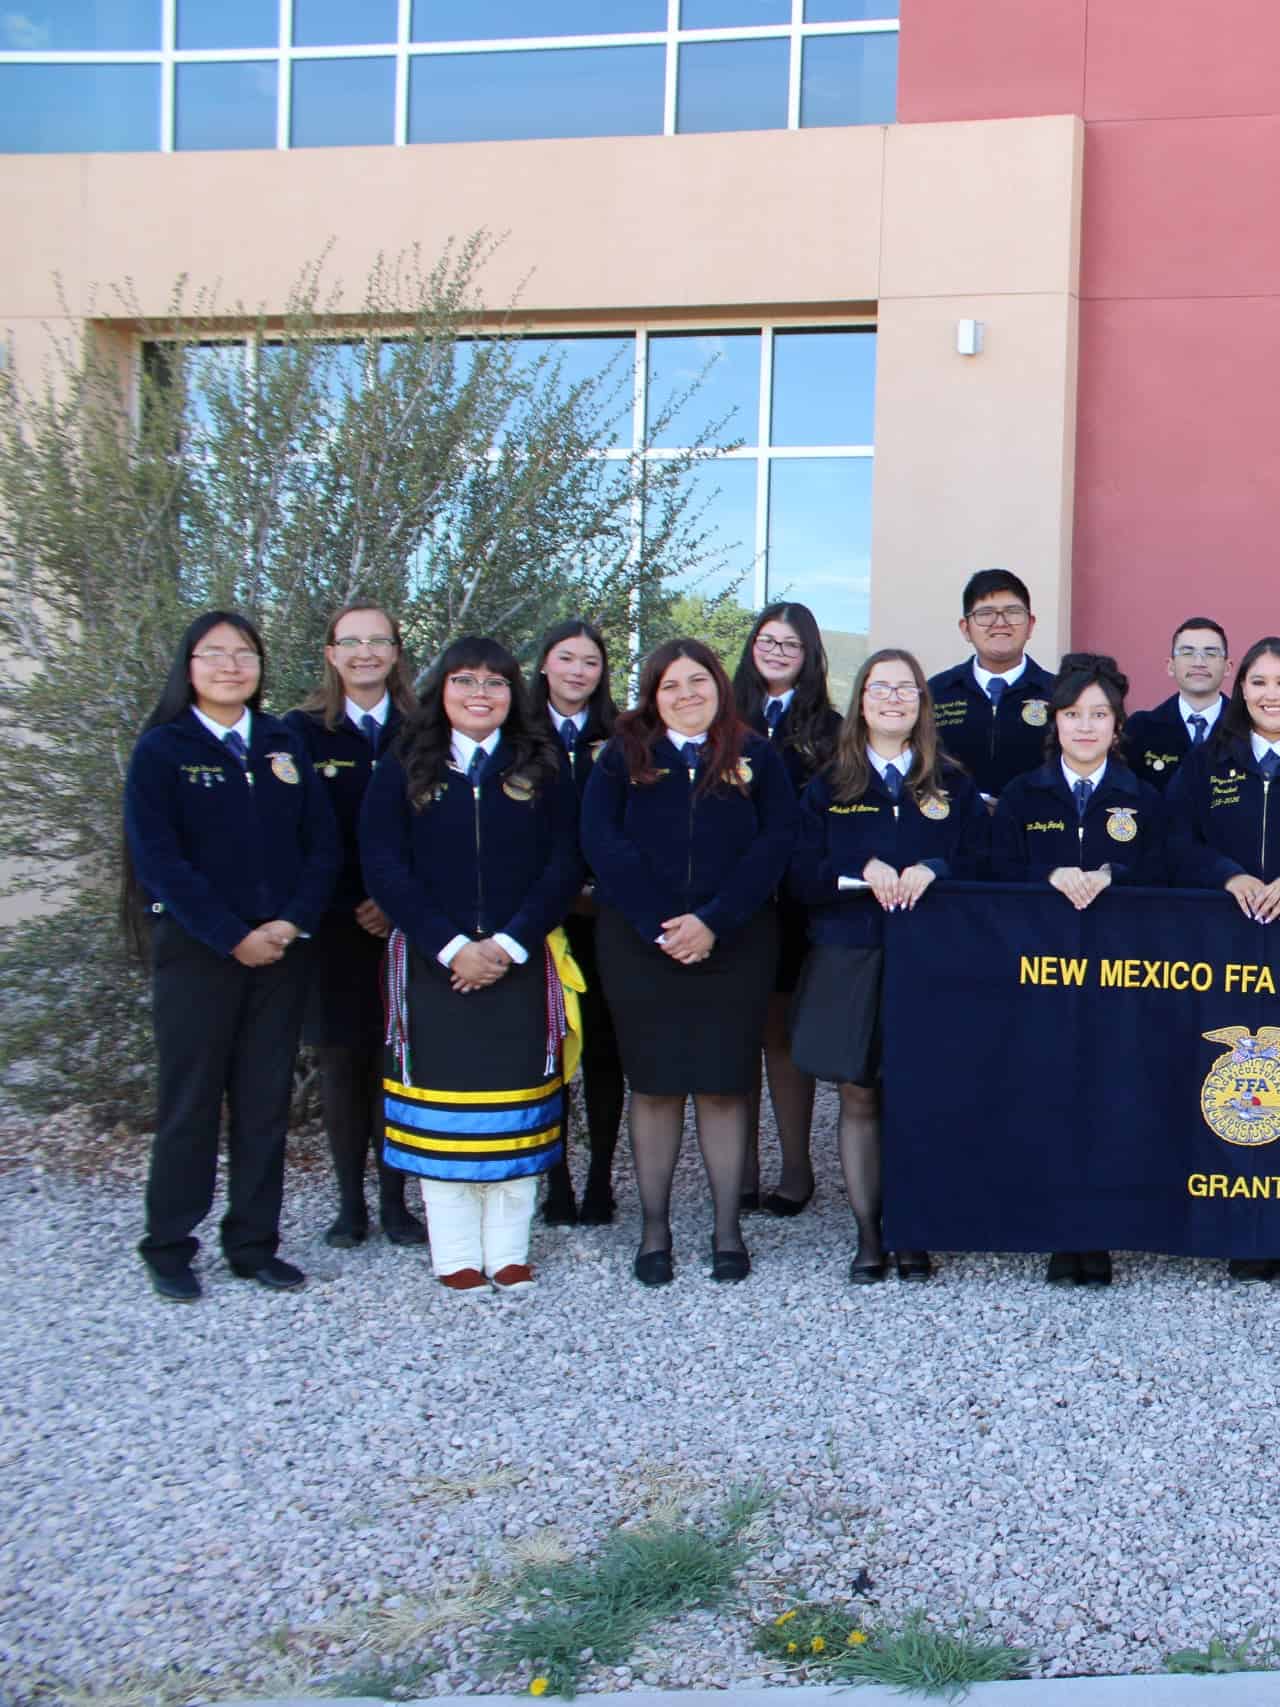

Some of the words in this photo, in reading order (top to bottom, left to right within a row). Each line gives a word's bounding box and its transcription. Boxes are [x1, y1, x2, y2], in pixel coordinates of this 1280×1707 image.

[1019, 955, 1087, 986] NEW
[1099, 959, 1213, 991] MEXICO
[1224, 963, 1275, 993] FFA
[1234, 1078, 1269, 1092] FFA
